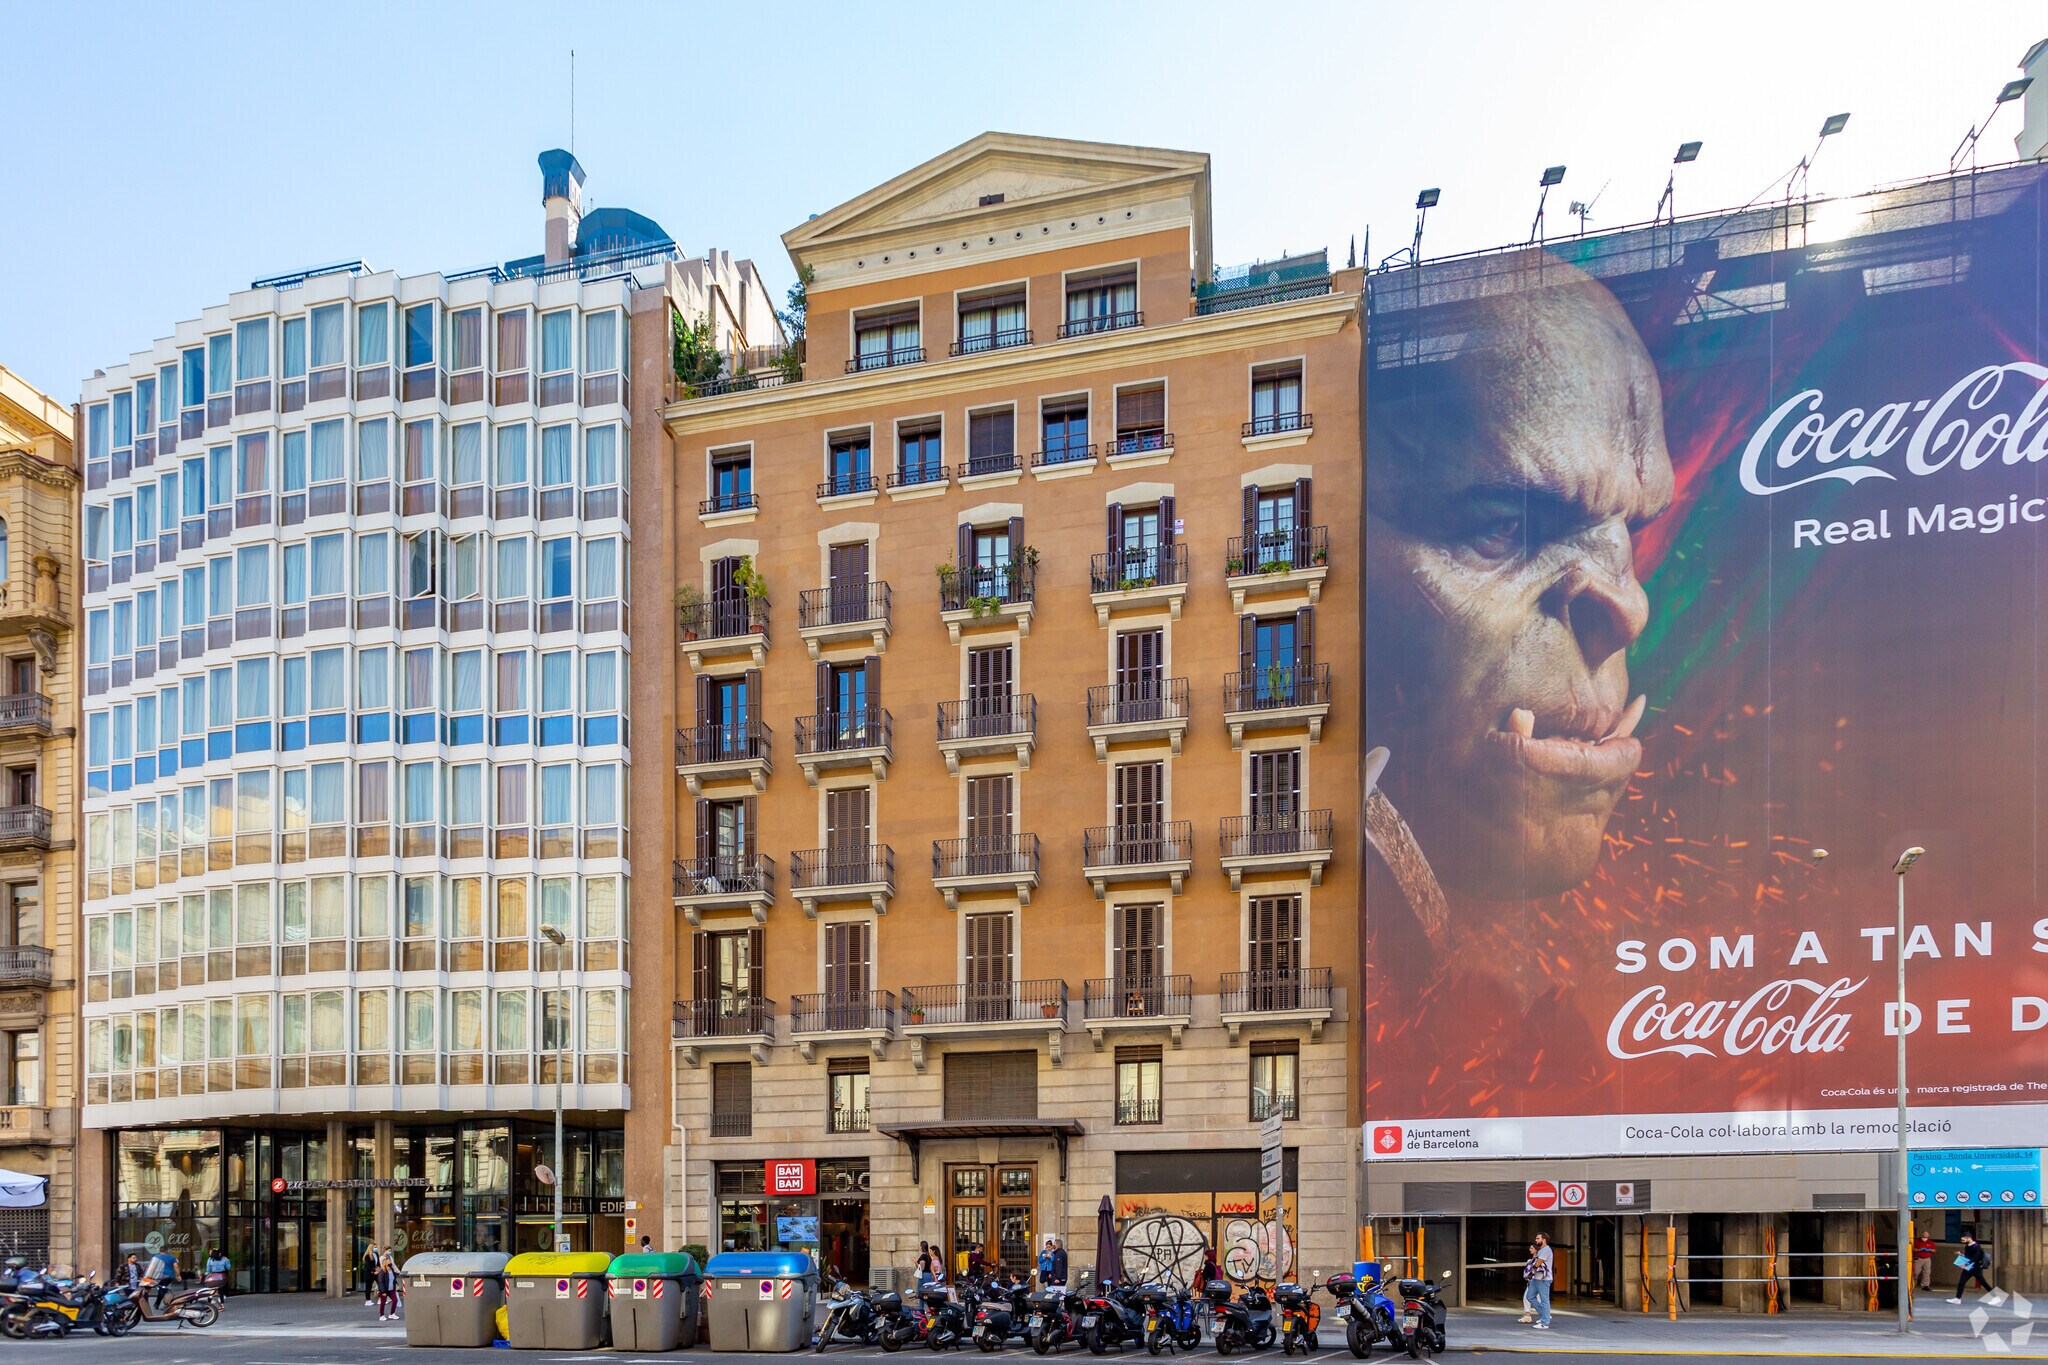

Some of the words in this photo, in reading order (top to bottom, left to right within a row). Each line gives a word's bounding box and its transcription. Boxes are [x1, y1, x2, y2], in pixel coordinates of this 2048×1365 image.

[1793, 509, 1892, 549] Real
[1907, 493, 2048, 536] Magic
[1614, 934, 1754, 974] SOM
[1788, 930, 1829, 966] A
[1860, 921, 1993, 962] TAN
[1606, 975, 1870, 1060] Coca-Cola
[1883, 998, 1972, 1036] DE
[1872, 1086, 1886, 1095] és
[1917, 1086, 1949, 1094] marca
[1952, 1083, 2007, 1094] registrada
[2009, 1082, 2025, 1091] de
[2026, 1081, 2048, 1090] The
[1406, 1128, 1471, 1141] Ajuntament
[1625, 1125, 1705, 1139] Coca-Cola
[1791, 1122, 1826, 1136] amb
[1831, 1121, 1845, 1135] la
[1406, 1140, 1421, 1150] de
[1423, 1139, 1479, 1149] Barcelona
[1913, 1153, 1942, 1161] Parking
[778, 1167, 800, 1176] BAM
[1942, 1166, 1953, 1174] 24
[339, 1179, 398, 1189] CATALUNYA
[778, 1179, 800, 1188] BAM
[168, 1232, 190, 1245] exe
[411, 1230, 434, 1242] exe
